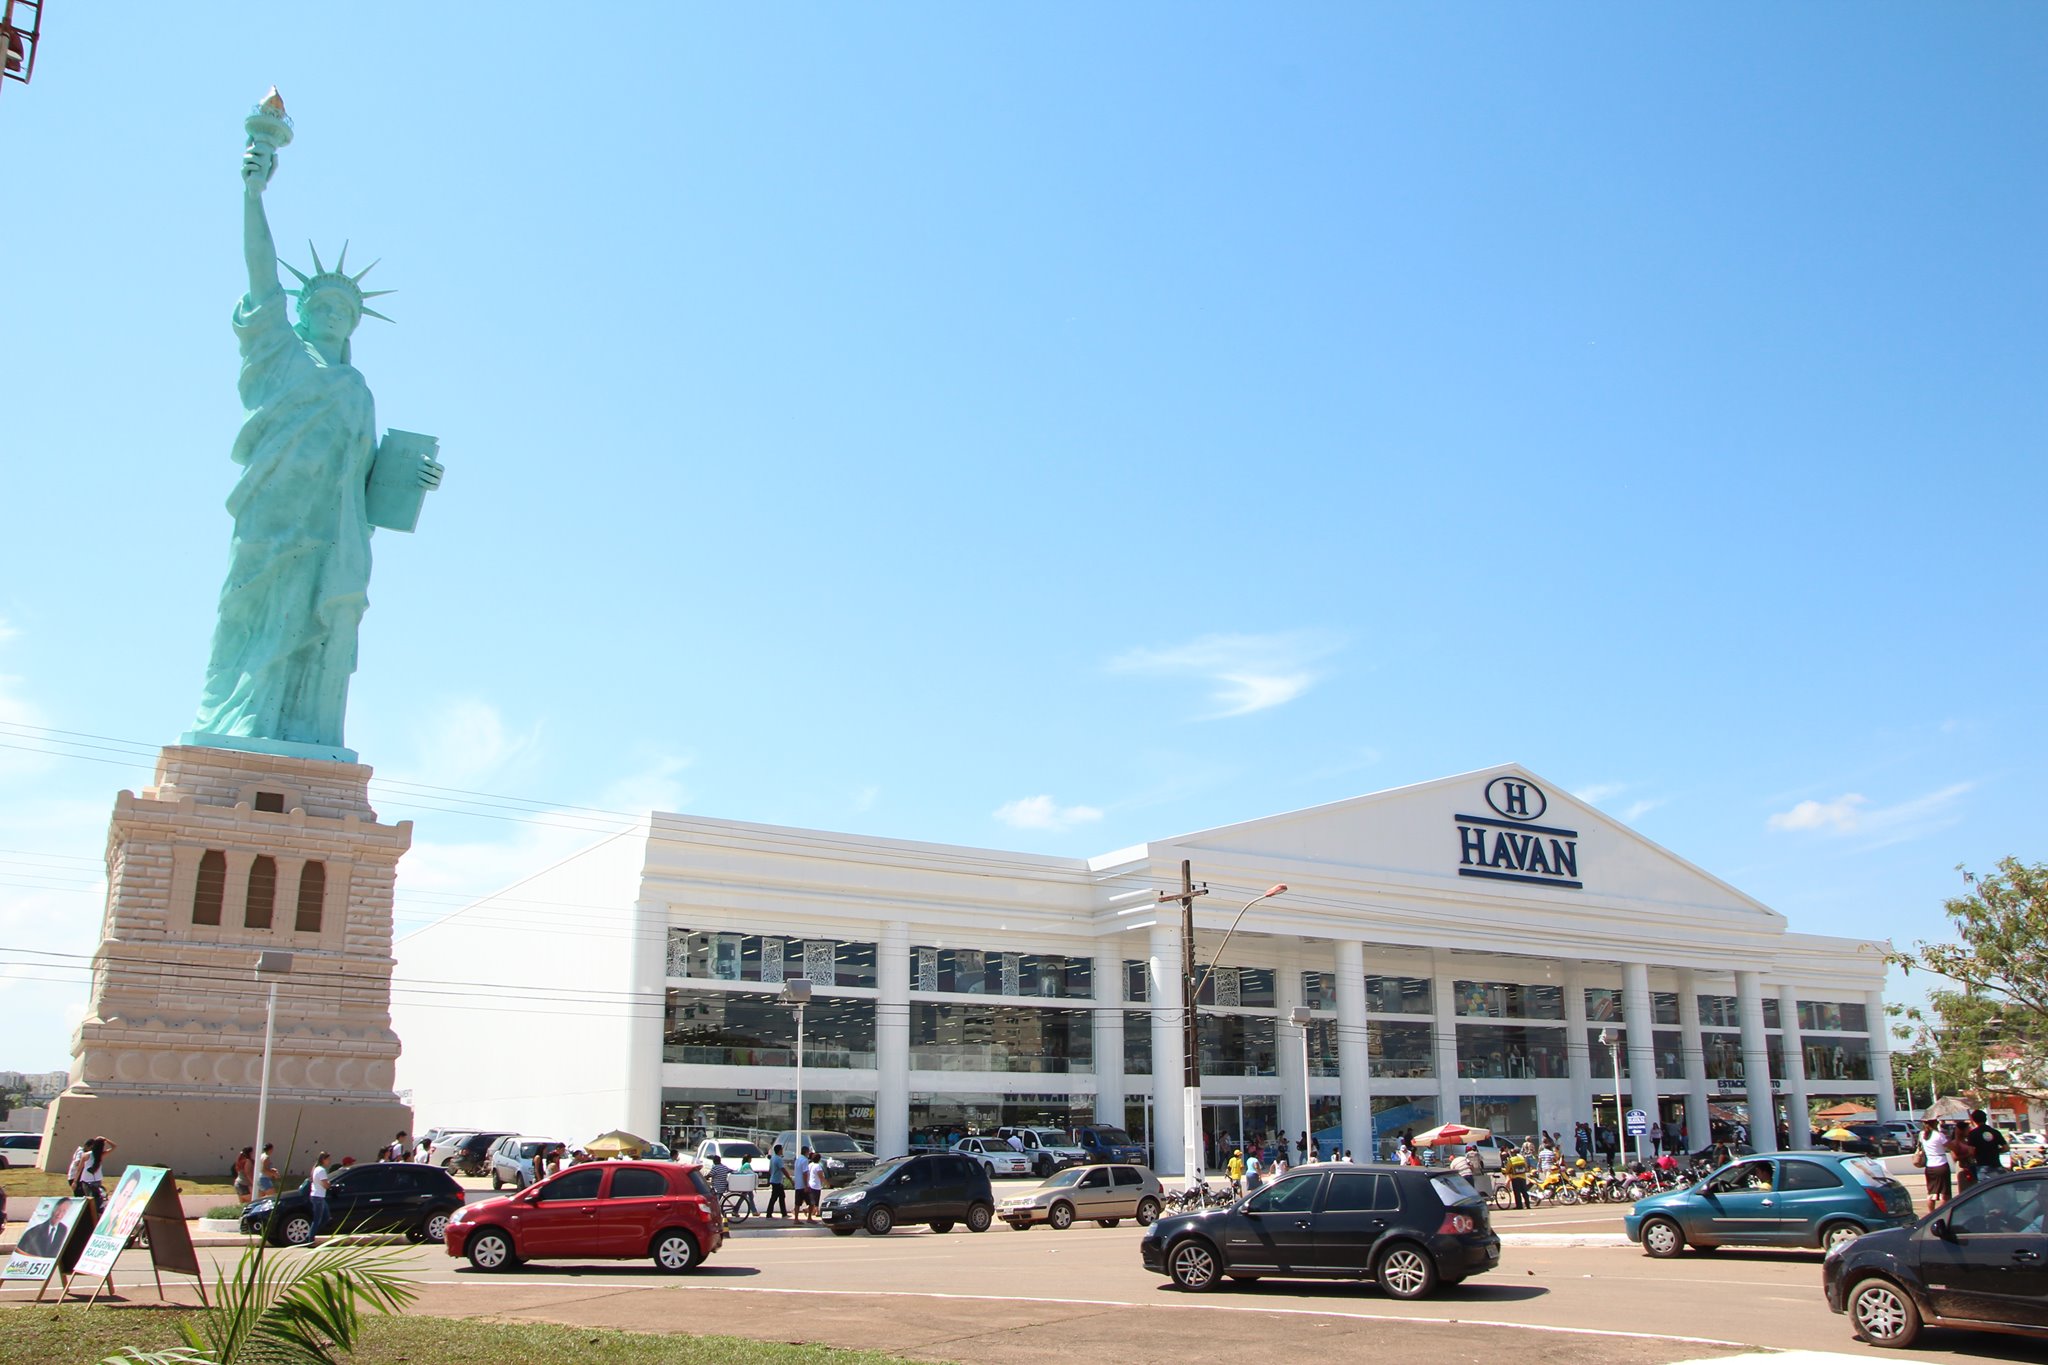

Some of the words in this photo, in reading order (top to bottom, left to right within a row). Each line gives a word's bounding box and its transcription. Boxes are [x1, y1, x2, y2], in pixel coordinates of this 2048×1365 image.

[1503, 782, 1529, 815] H
[1457, 826, 1578, 877] HAVAN
[91, 1239, 120, 1251] MARINHA
[27, 1263, 50, 1275] 1511
